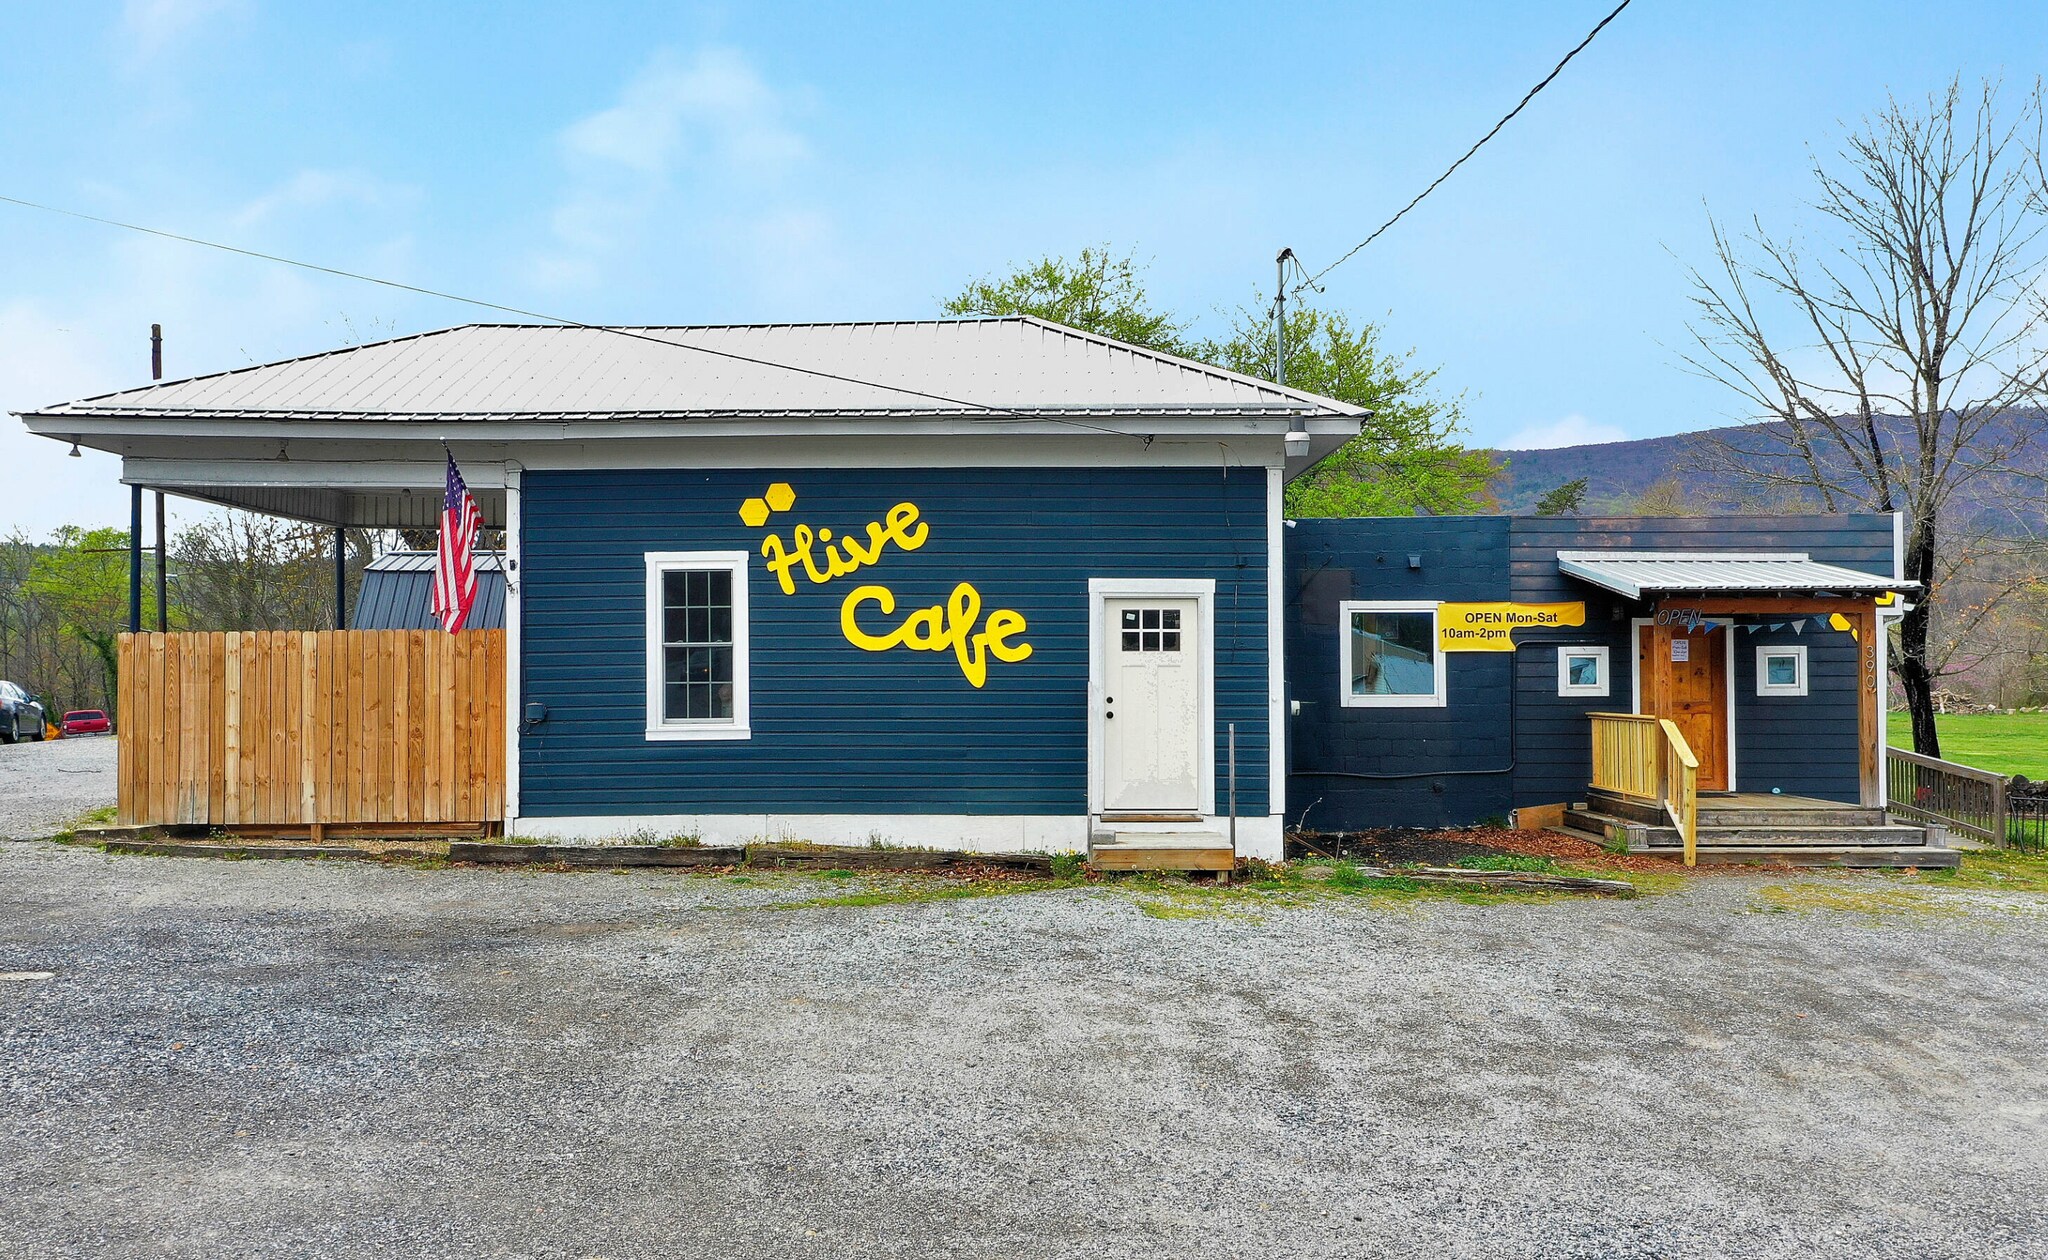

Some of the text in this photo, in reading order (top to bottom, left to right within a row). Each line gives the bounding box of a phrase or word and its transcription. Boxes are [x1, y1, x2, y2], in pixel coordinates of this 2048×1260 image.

[761, 502, 930, 595] Hive
[1465, 612, 1558, 623] OPEN Mon-Sat
[1657, 609, 1702, 626] OPEN
[840, 582, 1033, 688] Cafe
[1441, 627, 1506, 640] 10am-2pm
[1865, 645, 1875, 688] 390
